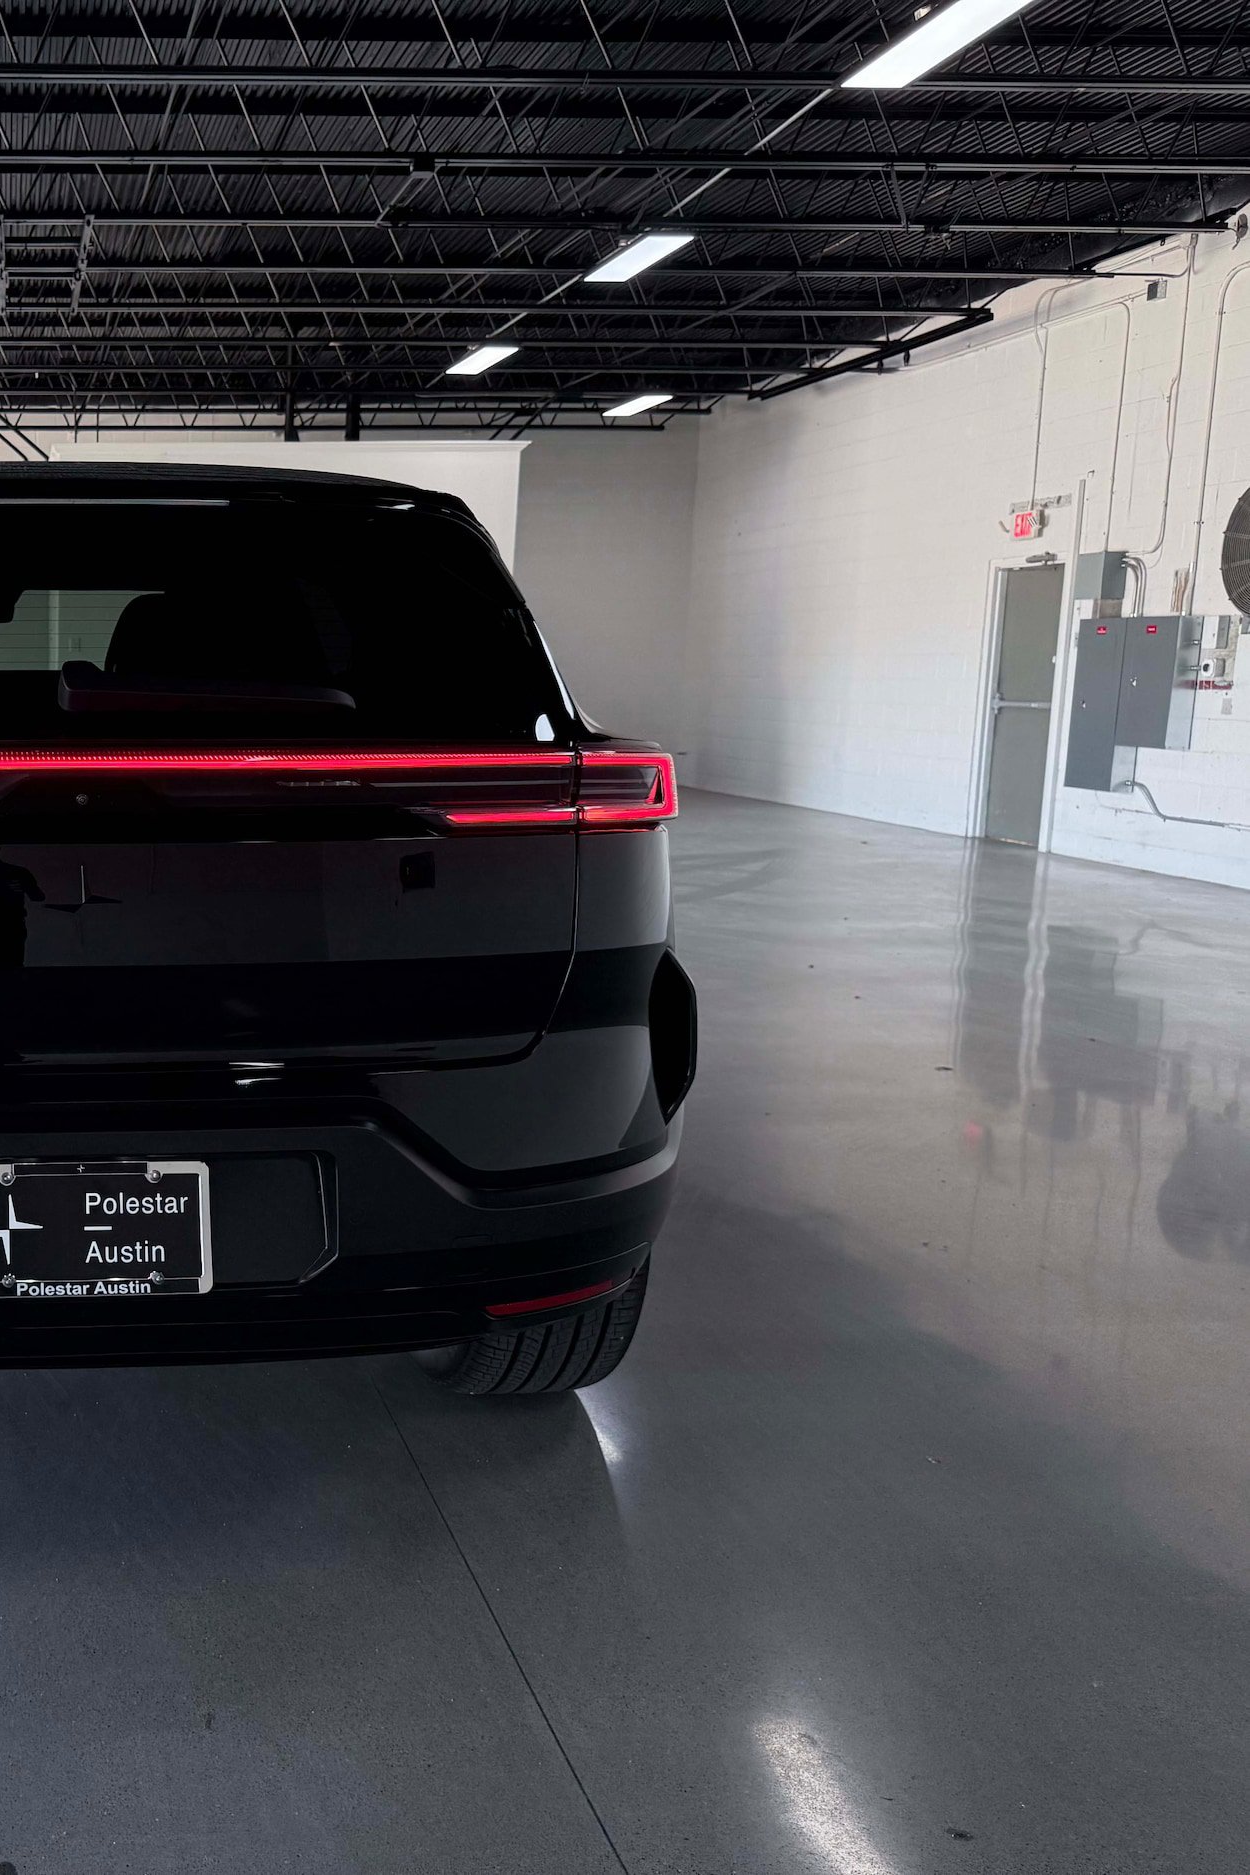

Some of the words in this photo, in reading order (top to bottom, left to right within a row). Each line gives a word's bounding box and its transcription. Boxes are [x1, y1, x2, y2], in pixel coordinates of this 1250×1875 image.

[84, 1191, 189, 1215] Polestar
[85, 1240, 166, 1264] Austin
[16, 1282, 90, 1297] Polestar
[94, 1280, 151, 1295] Austin
